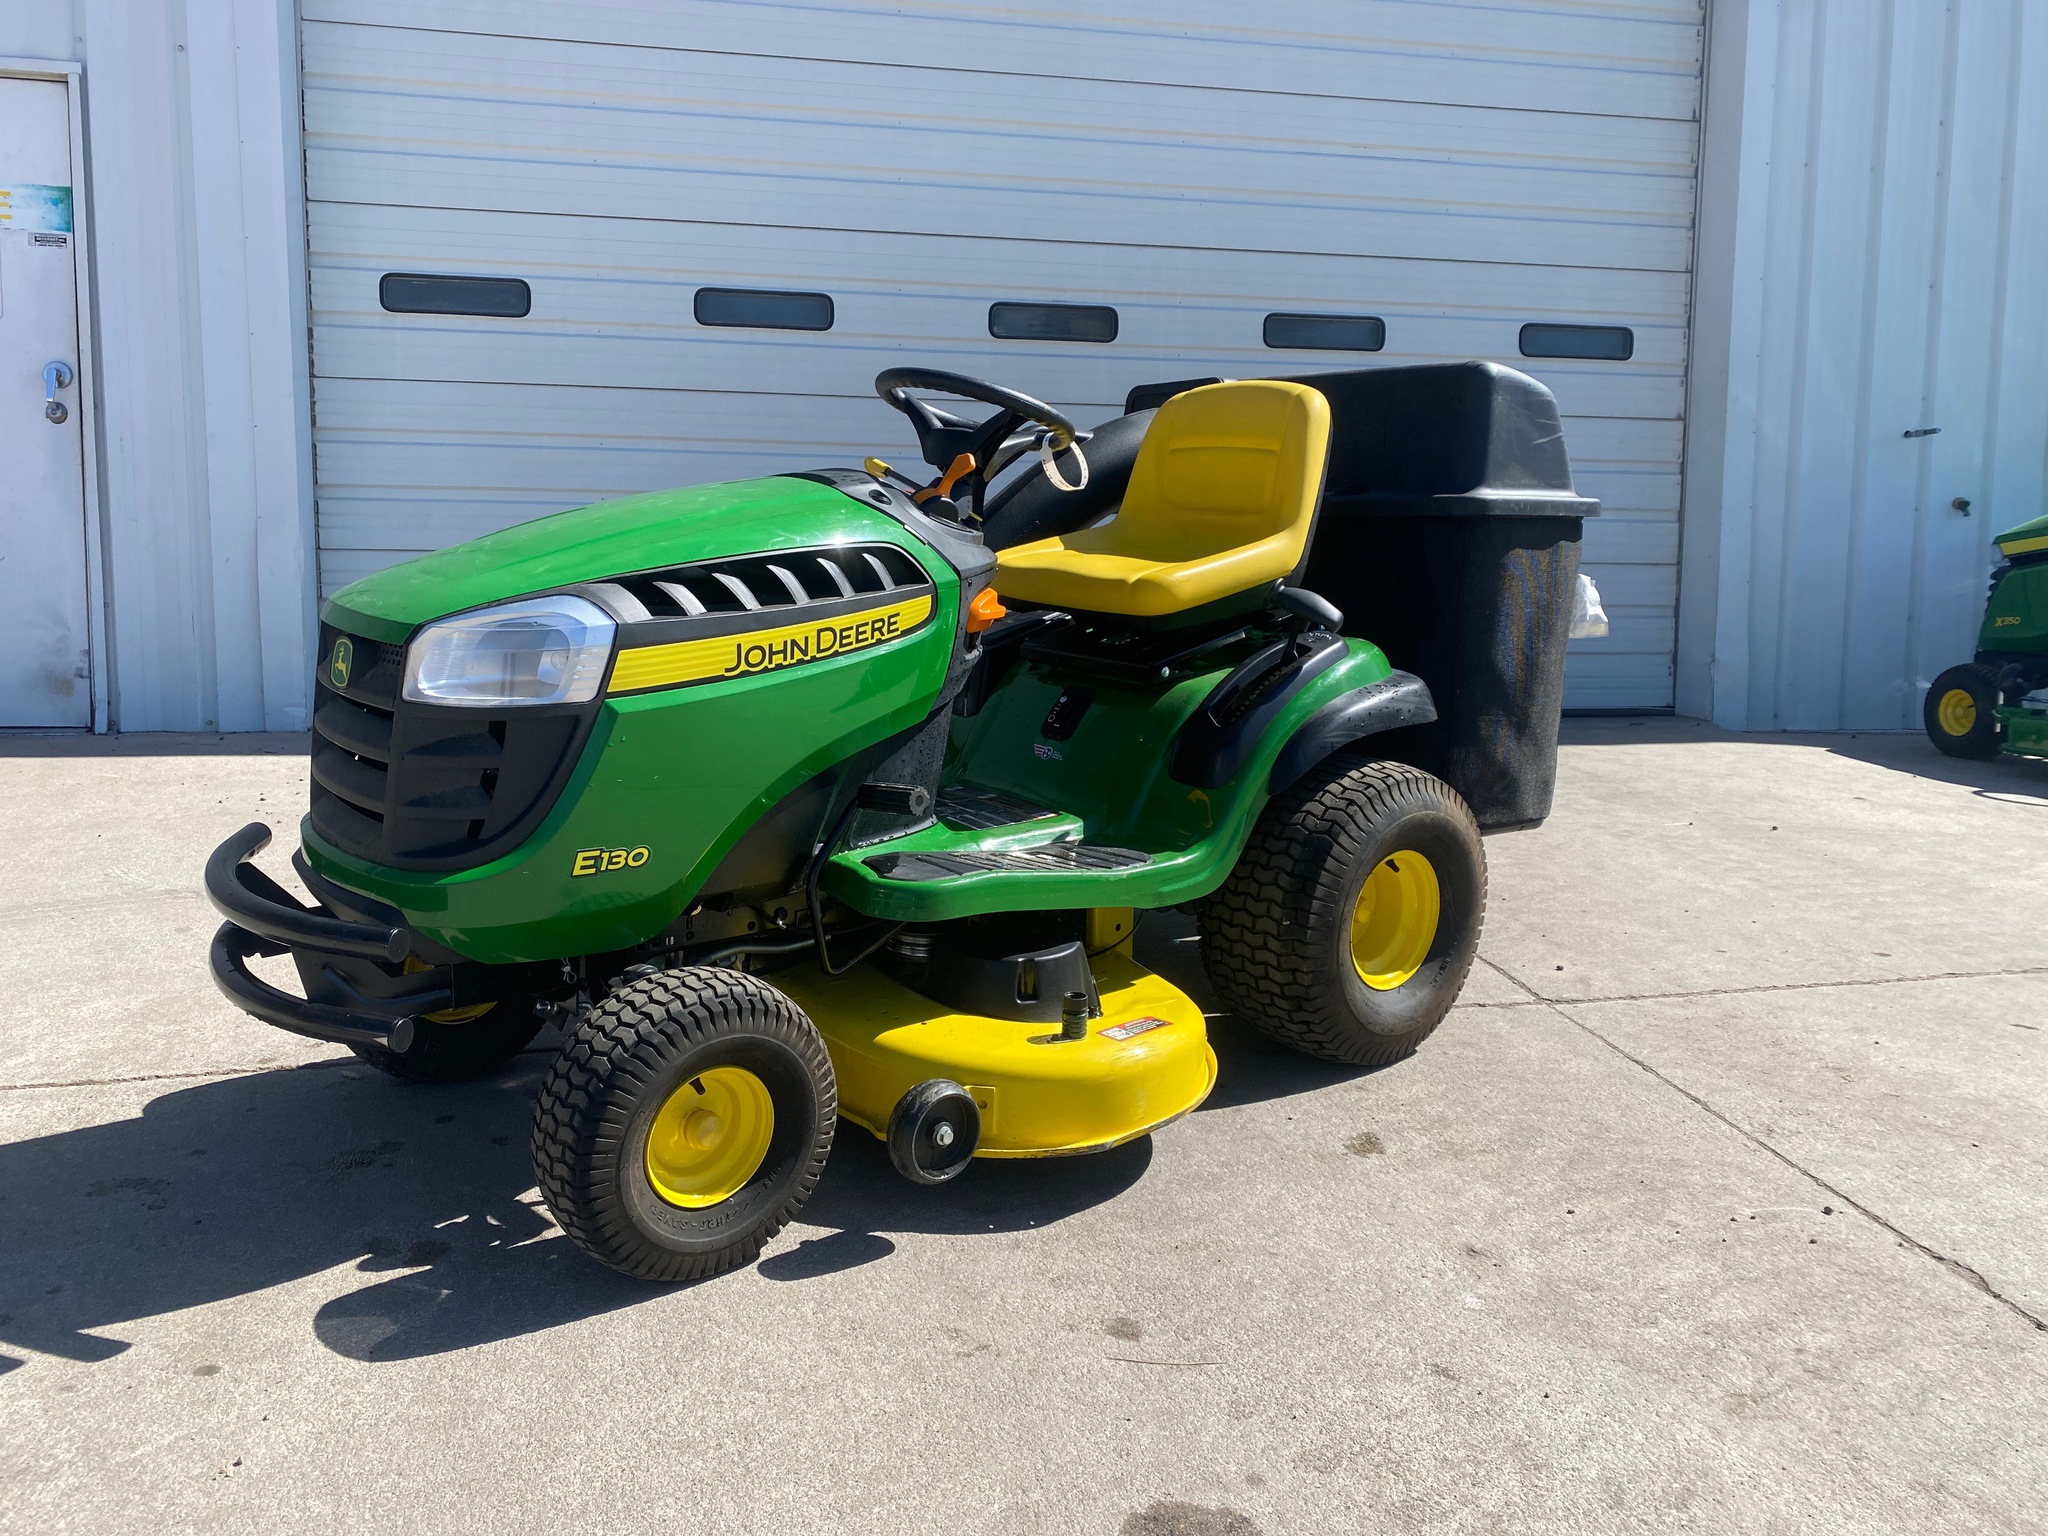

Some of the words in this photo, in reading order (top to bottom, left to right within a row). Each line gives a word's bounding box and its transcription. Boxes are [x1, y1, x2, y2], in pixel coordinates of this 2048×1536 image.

[1994, 616, 2021, 627] X350
[724, 642, 809, 674] JOHN
[816, 612, 901, 652] DEERE
[572, 846, 650, 877] E130
